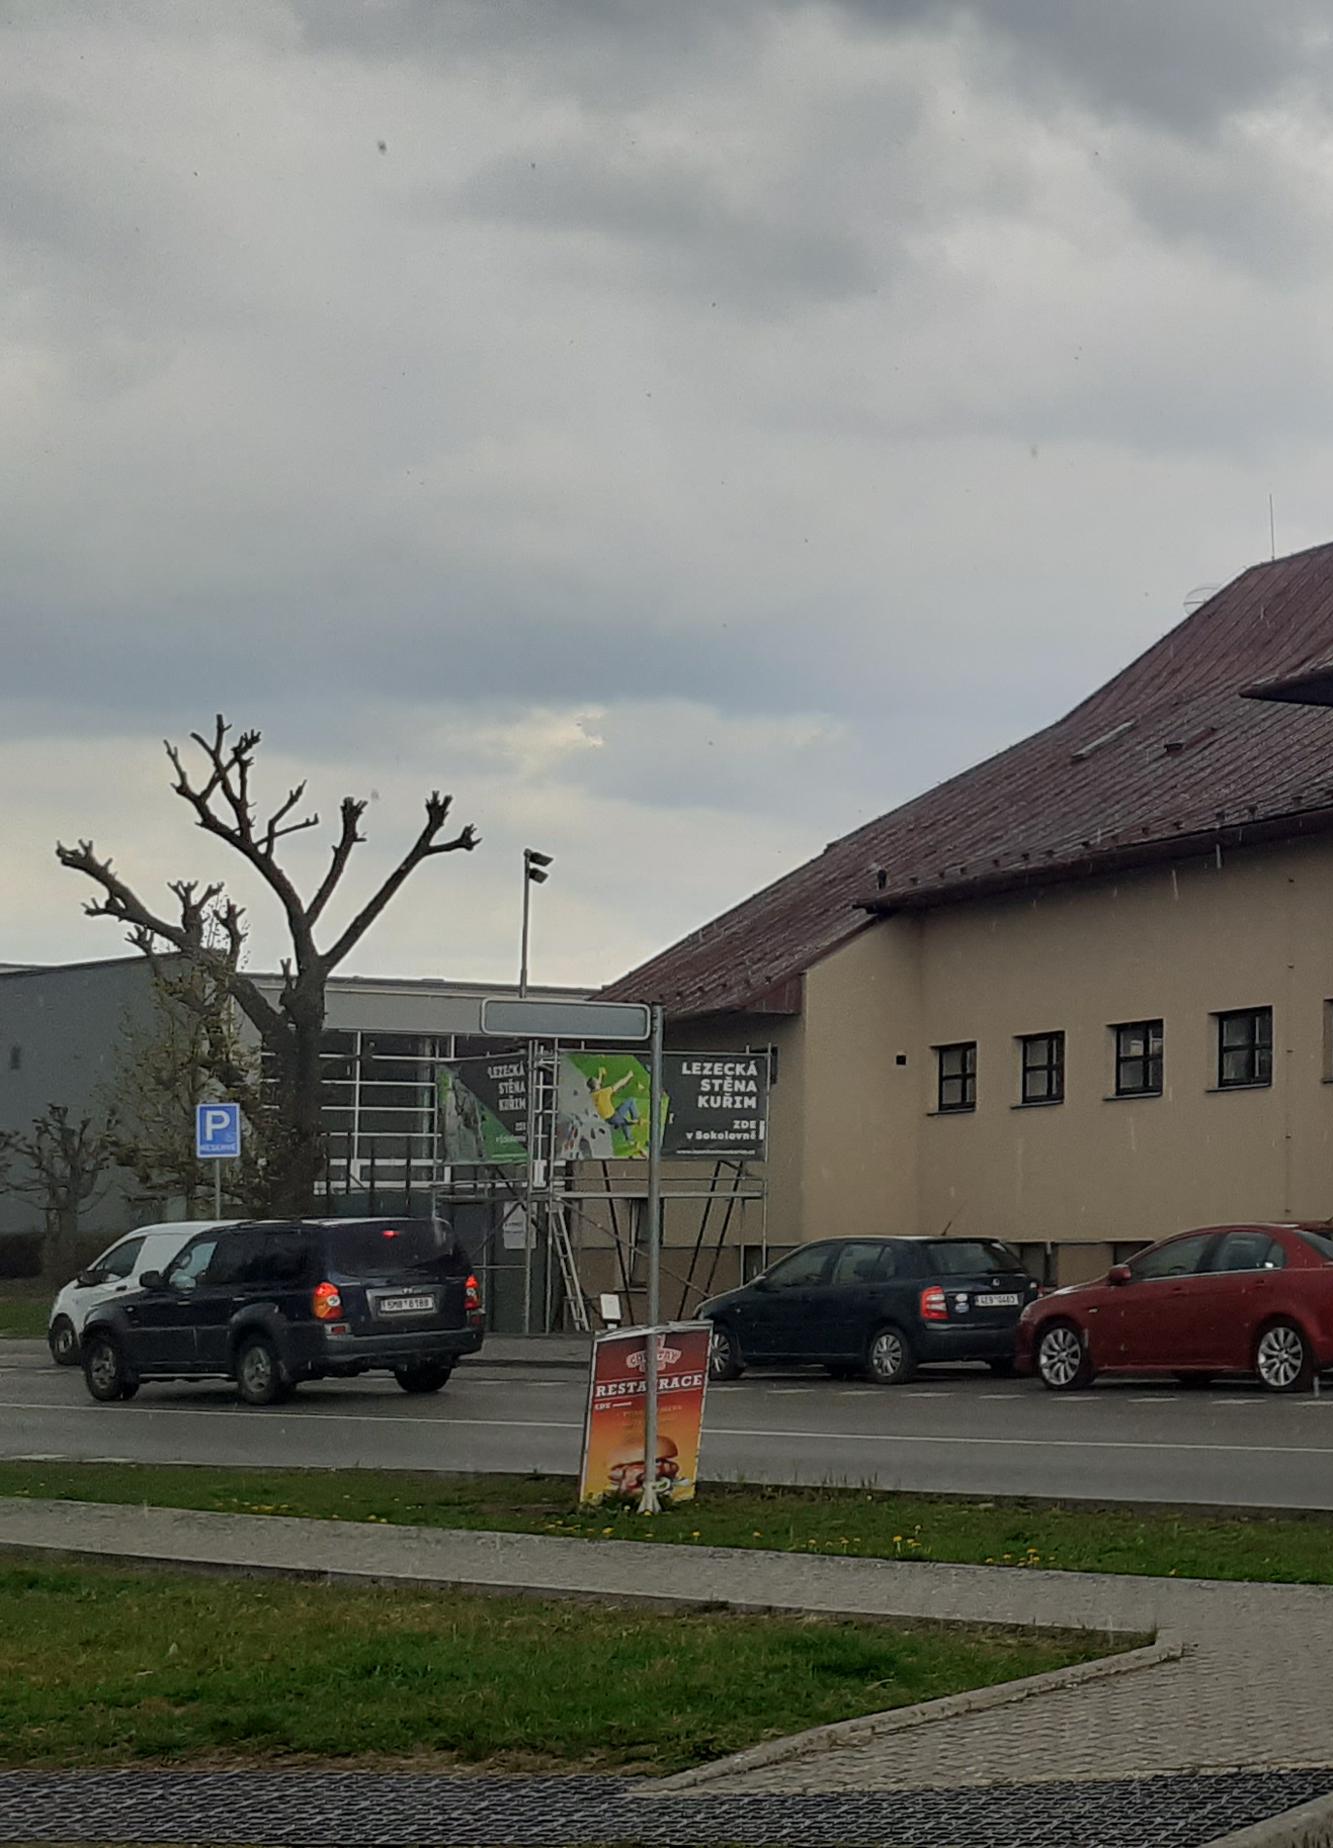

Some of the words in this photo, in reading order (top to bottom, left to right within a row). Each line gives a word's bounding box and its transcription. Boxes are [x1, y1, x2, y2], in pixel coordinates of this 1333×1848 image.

[681, 1061, 758, 1076] LEZECKÁ
[498, 1079, 526, 1094] STĚNA
[700, 1076, 758, 1092] STĚNA
[697, 1093, 757, 1109] KUŘIM
[206, 1110, 230, 1141] P
[733, 1120, 757, 1129] ZDE
[686, 1132, 693, 1140] v
[695, 1130, 756, 1140] Sokolovně
[596, 1375, 702, 1397] RESTARACE
